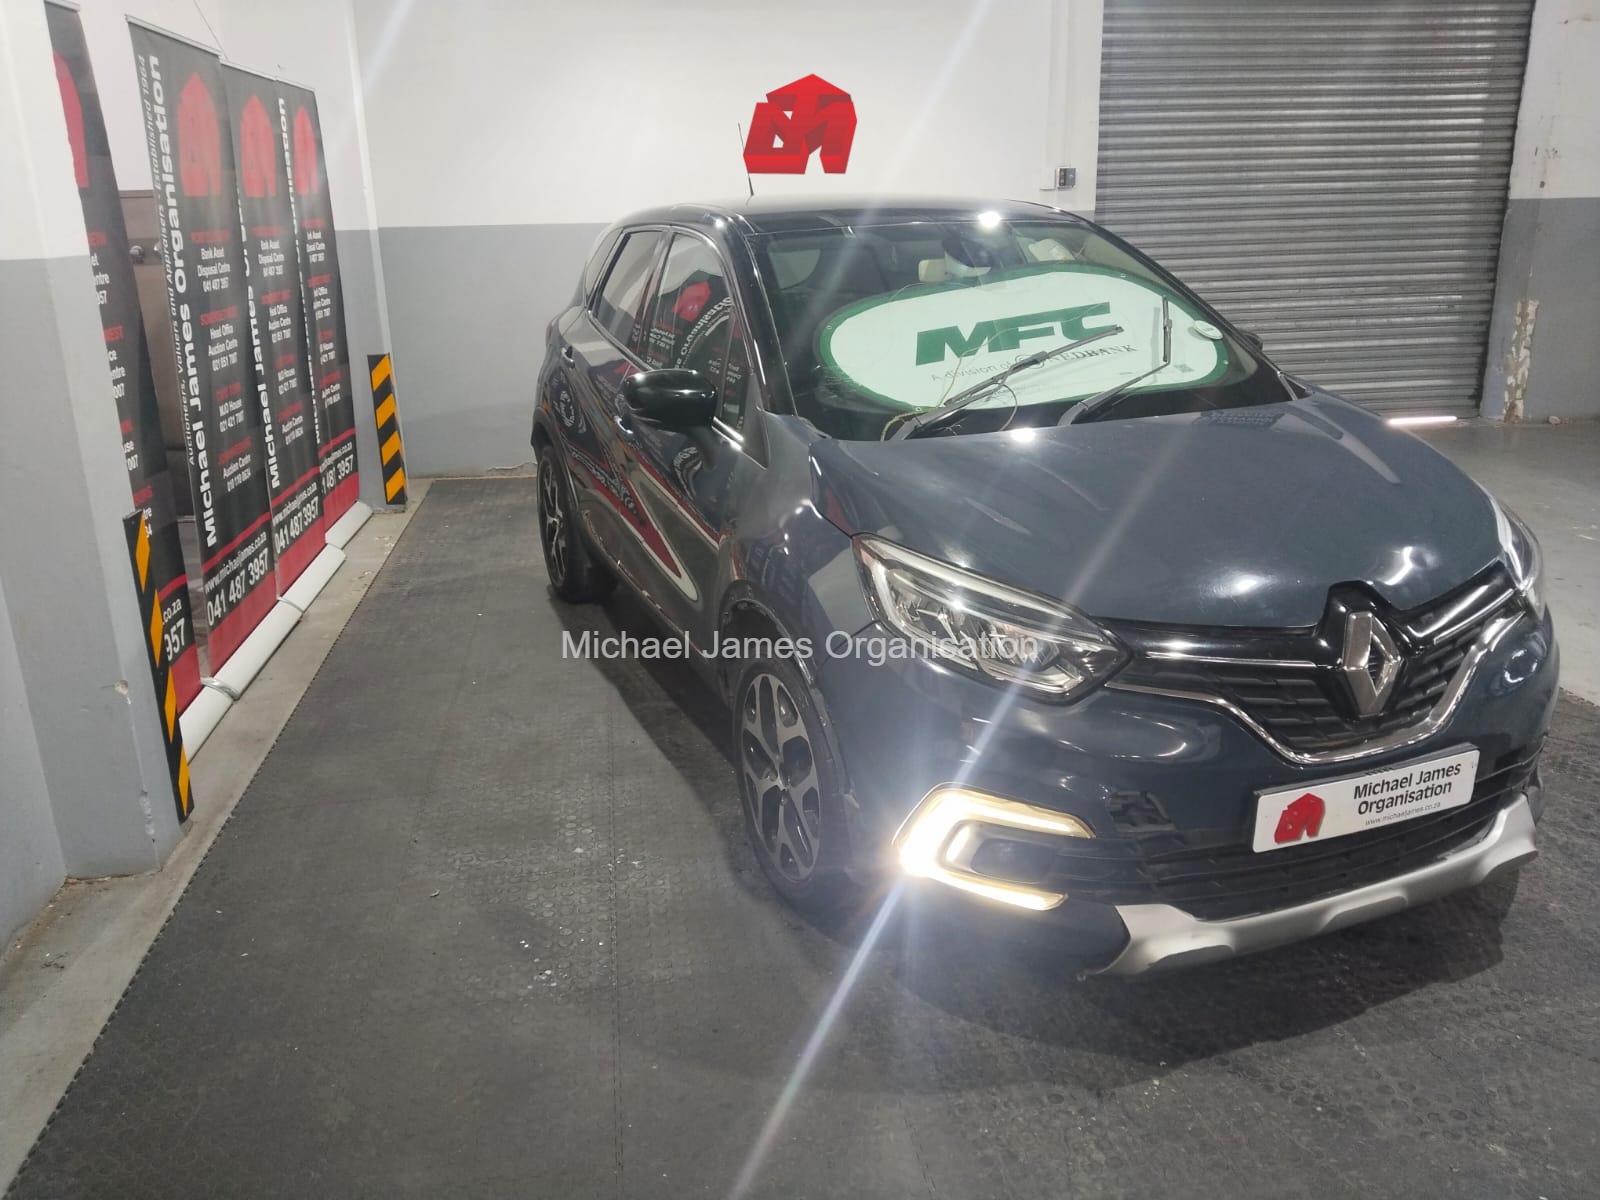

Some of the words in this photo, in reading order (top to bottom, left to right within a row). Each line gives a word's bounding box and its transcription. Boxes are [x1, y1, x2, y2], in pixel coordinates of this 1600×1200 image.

[149, 55, 187, 293] Organisation
[158, 204, 174, 283] Appraisers
[168, 286, 177, 316] and
[173, 320, 184, 373] Valuers
[180, 303, 201, 412] James
[915, 301, 1115, 366] MFC
[257, 383, 280, 489] Michael
[192, 420, 217, 548] Michael
[275, 524, 290, 554] 041
[290, 511, 303, 539] 487
[303, 496, 318, 526] 3957
[207, 588, 226, 626] 041
[229, 569, 245, 603] 487
[248, 547, 268, 585] 3957
[164, 617, 184, 661] 957
[1354, 773, 1413, 800] Michael
[1416, 763, 1462, 785] James
[1358, 782, 1452, 815] Organisation
[1365, 802, 1441, 826] www.michaeljames.co.za
